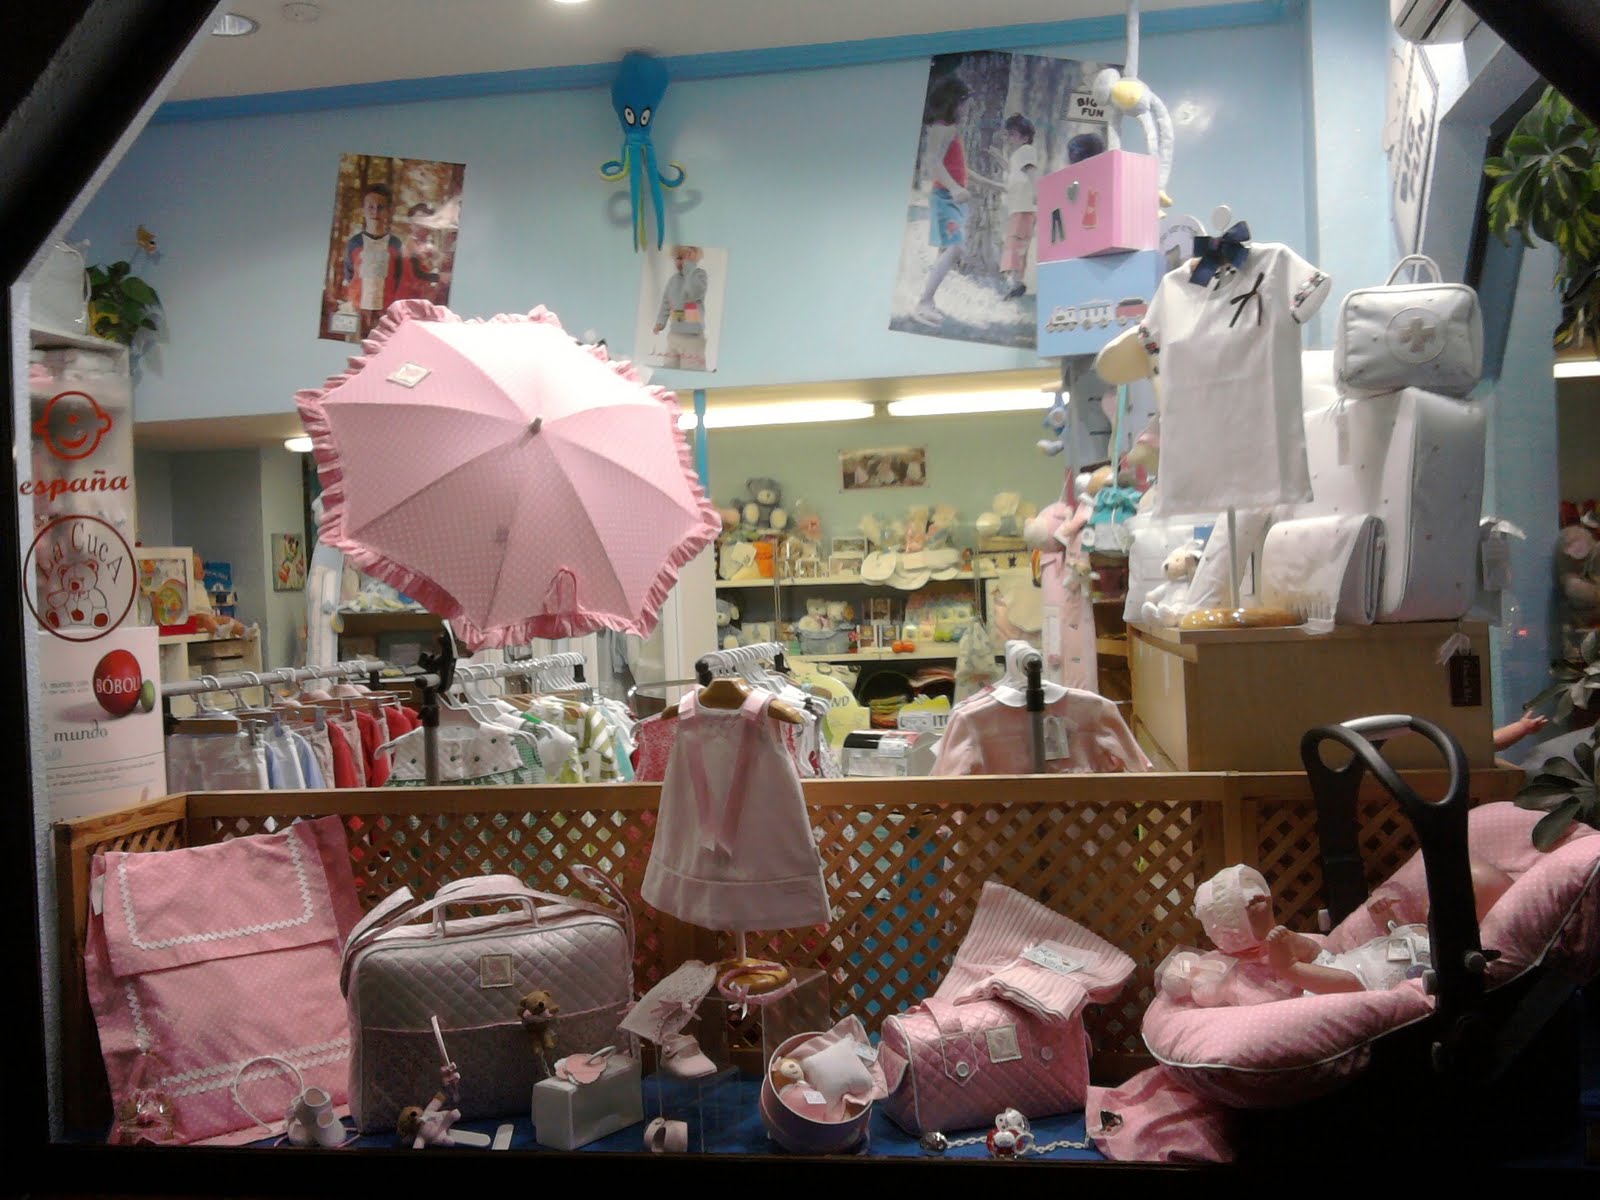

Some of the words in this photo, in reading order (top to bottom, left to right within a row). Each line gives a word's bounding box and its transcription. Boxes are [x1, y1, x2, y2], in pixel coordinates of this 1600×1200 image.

[1077, 97, 1098, 107] BIG
[1081, 107, 1104, 118] FUN
[20, 469, 129, 502] españa
[54, 719, 108, 742] mundo
